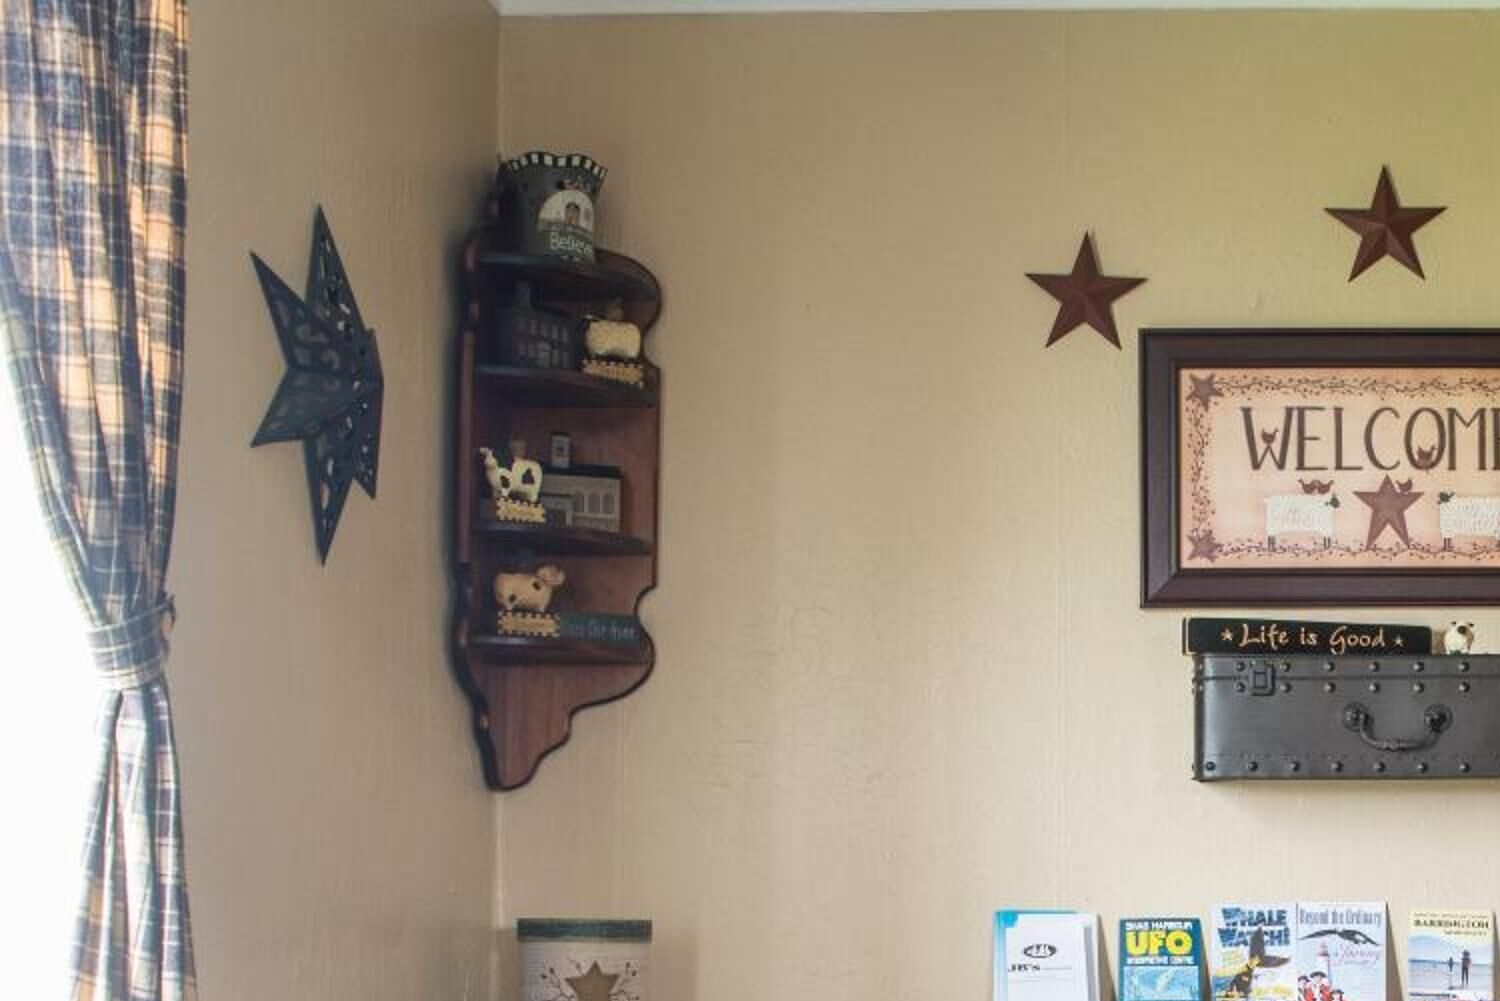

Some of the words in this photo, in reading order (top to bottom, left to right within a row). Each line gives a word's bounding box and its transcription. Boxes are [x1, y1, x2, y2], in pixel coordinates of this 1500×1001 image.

[1238, 623, 1290, 651] Life
[1300, 627, 1318, 646] is
[1329, 626, 1386, 655] Good
[1222, 907, 1287, 927] WHALE
[1125, 930, 1193, 957] UFO
